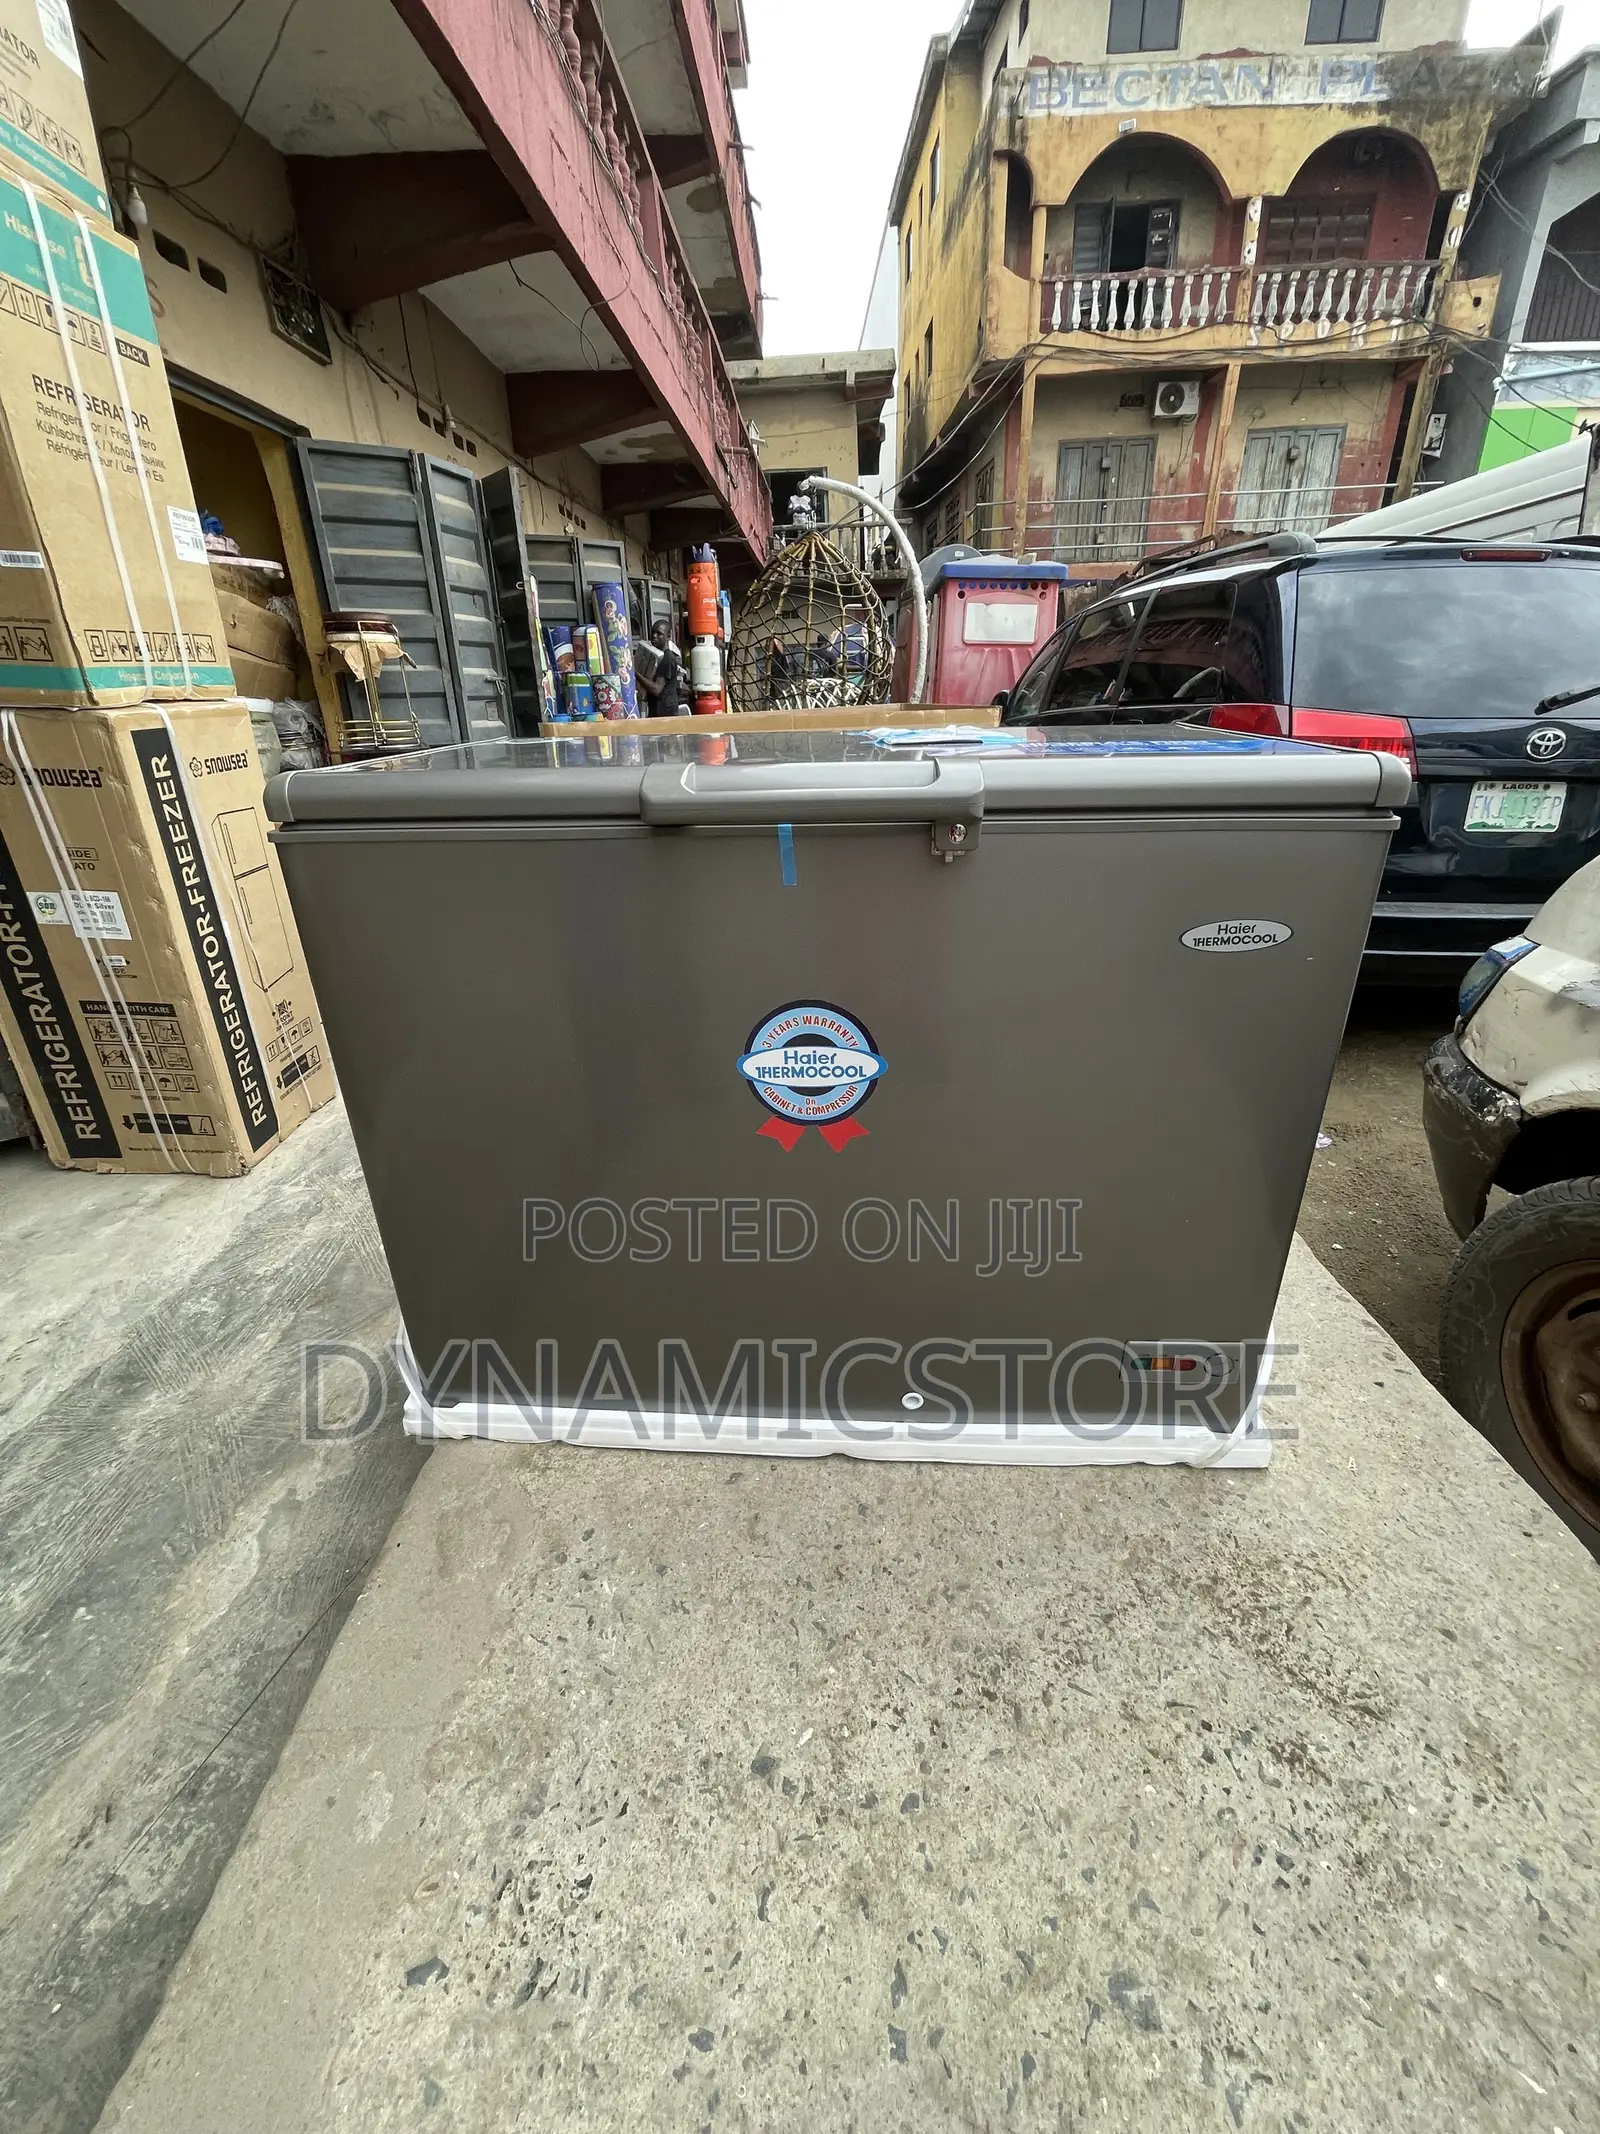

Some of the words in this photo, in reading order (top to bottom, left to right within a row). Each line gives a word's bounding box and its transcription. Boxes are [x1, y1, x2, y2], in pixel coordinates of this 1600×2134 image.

[1028, 63, 1276, 110] BECTAN
[118, 341, 147, 364] BACK
[31, 373, 151, 432] REFRGERAOR
[36, 401, 101, 434] Refrigeraor
[35, 418, 101, 450] Kühlschrak
[73, 861, 96, 871] ATO
[151, 753, 267, 1127] REFRIGERATOR-FREEZER
[1192, 933, 1279, 947] THERMOCOOL
[1217, 923, 1257, 935] Haier
[86, 1003, 123, 1012] HANE
[148, 1005, 171, 1014] CARE
[761, 1039, 772, 1048] 3
[767, 1017, 800, 1041] YEARS
[802, 1015, 860, 1048] WARRANTY
[783, 1050, 837, 1065] Haier
[755, 1065, 867, 1079] THERMOCOOL
[763, 1086, 796, 1112] CABINET
[805, 1085, 859, 1116] COMPRESSOR
[805, 1097, 816, 1105] On
